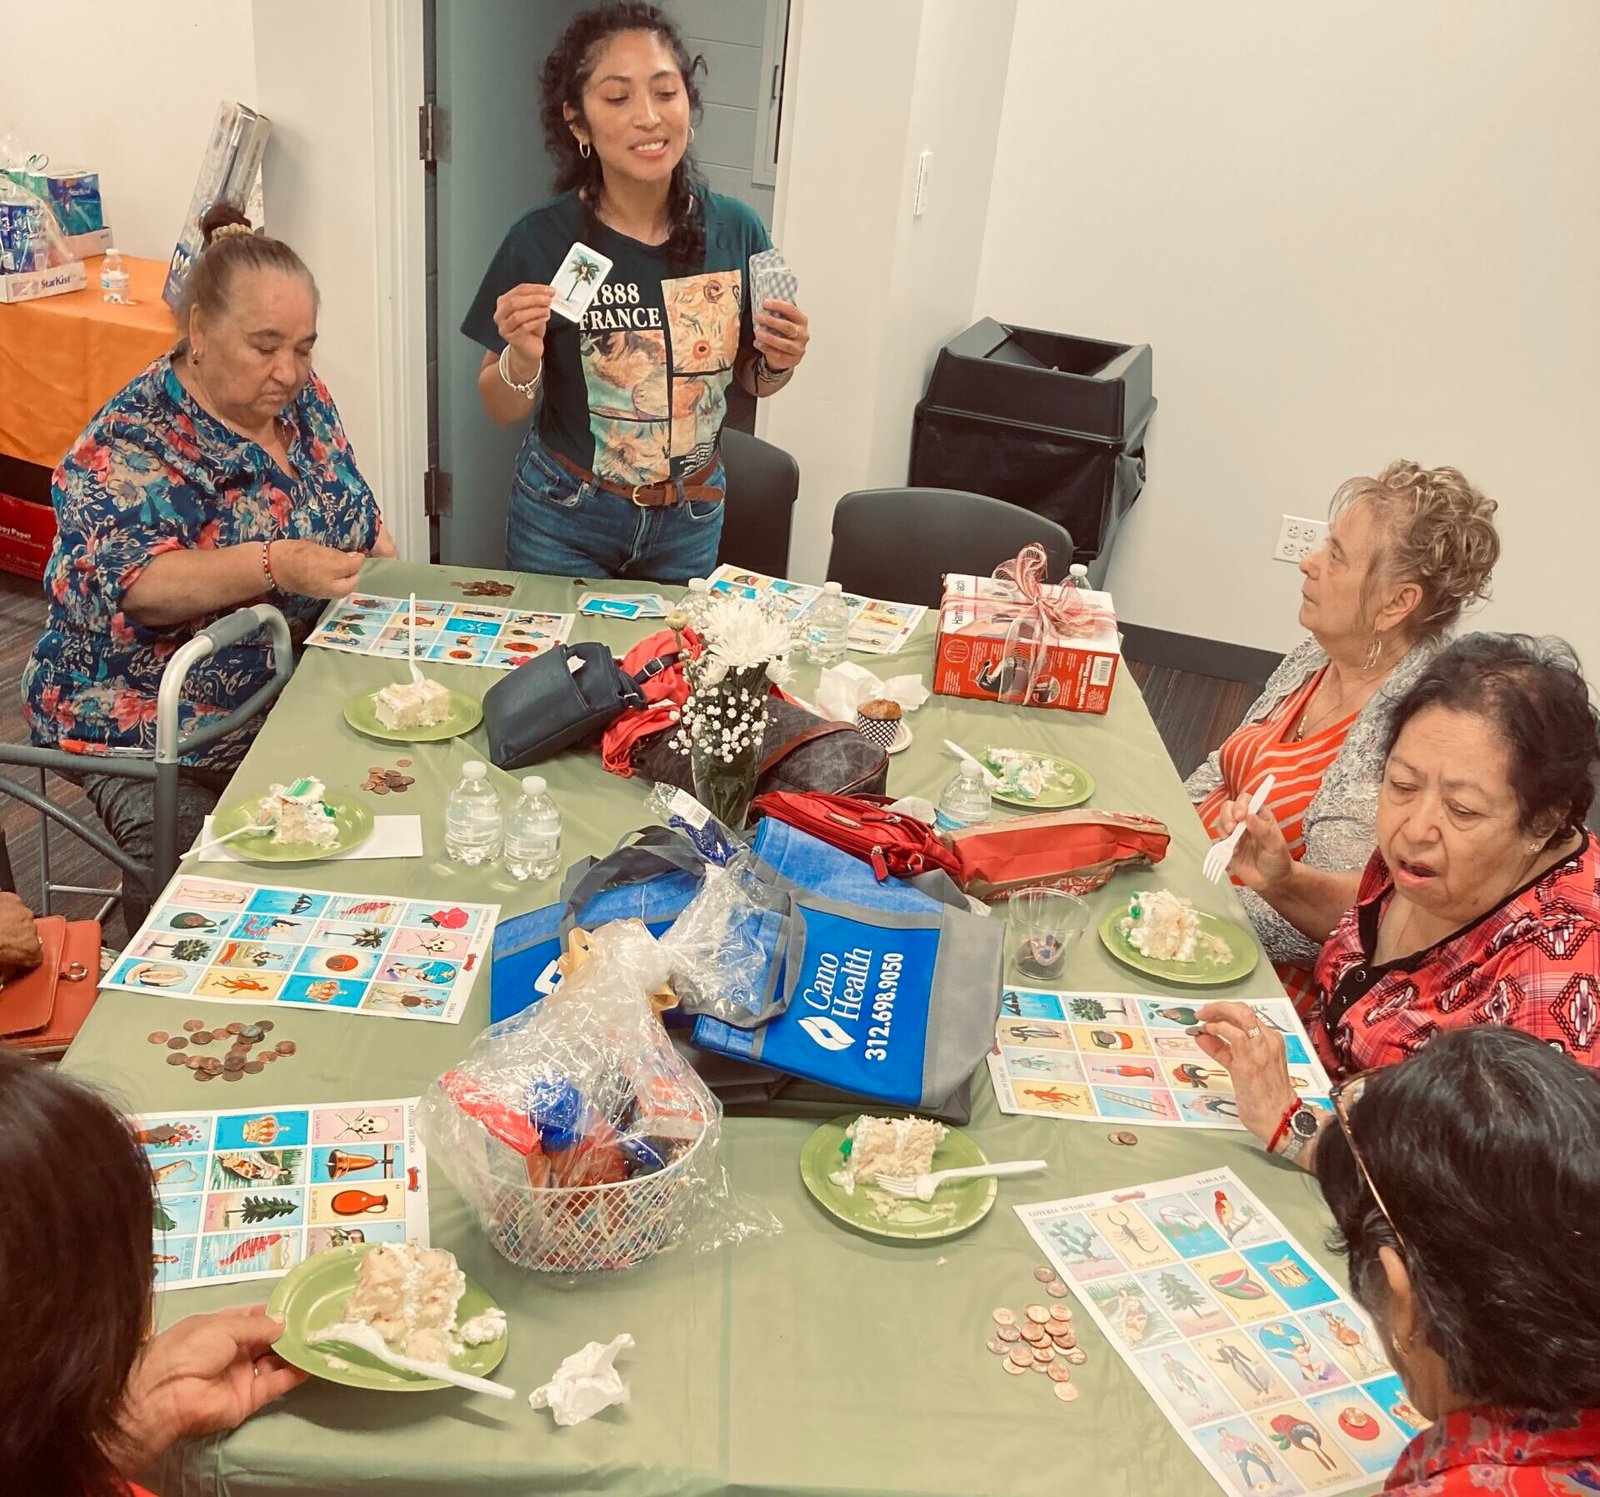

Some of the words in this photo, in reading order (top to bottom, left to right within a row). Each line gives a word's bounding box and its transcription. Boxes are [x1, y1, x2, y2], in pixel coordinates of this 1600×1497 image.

[41, 275, 71, 289] StarKist
[592, 282, 641, 307] 1888
[579, 307, 662, 331] FRANCE
[1082, 654, 1093, 677] Beach
[1077, 677, 1088, 709] Hamilton
[803, 953, 839, 1011] Cano
[831, 948, 873, 1021] Health
[865, 953, 904, 1061] 312.698.9050
